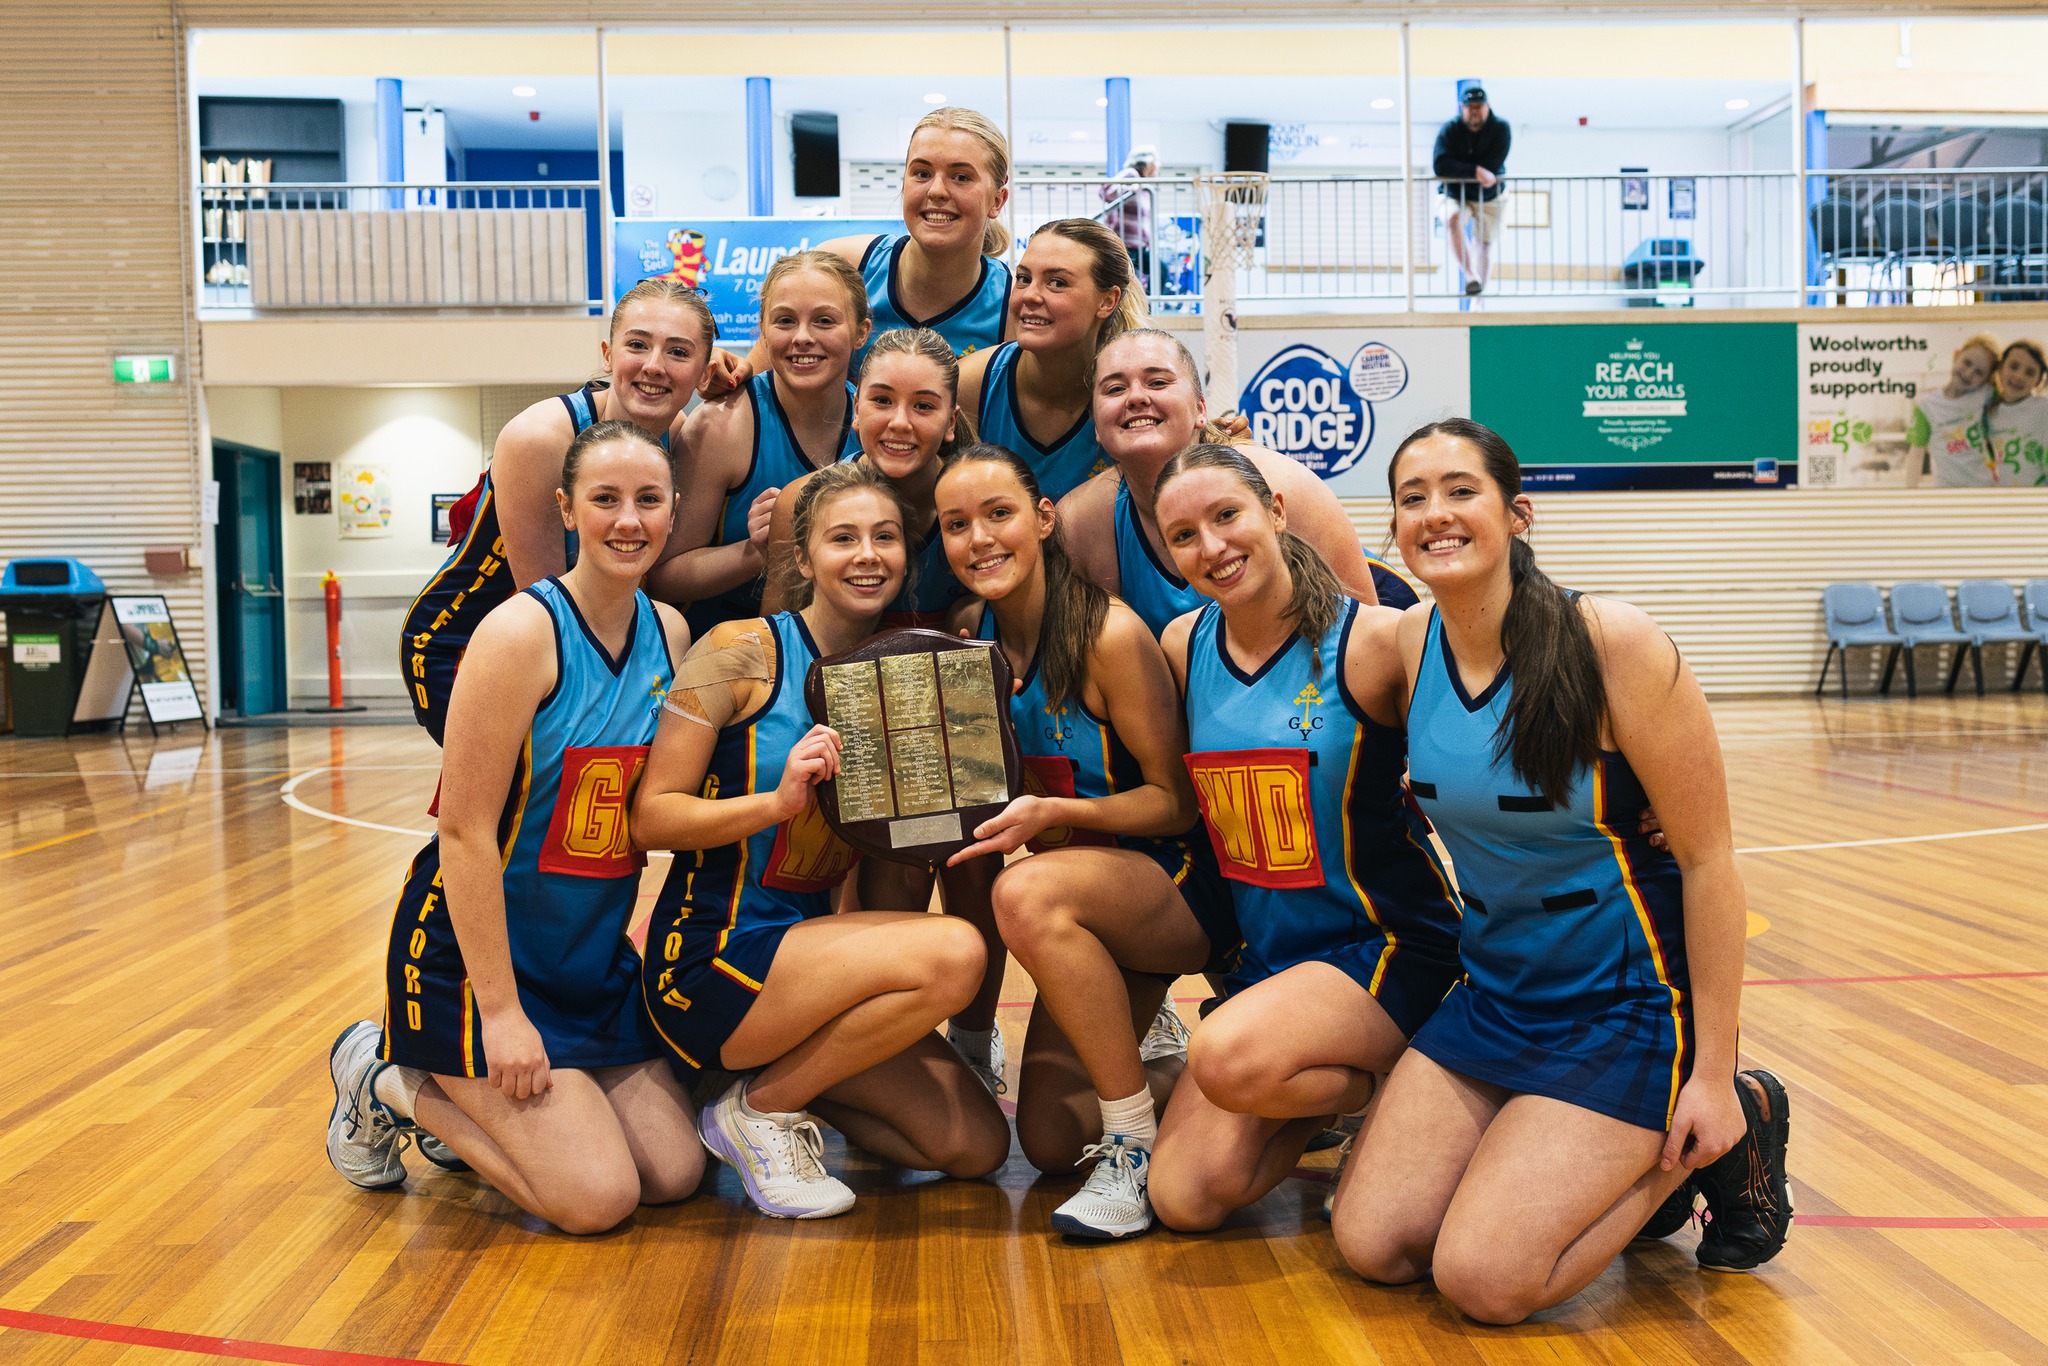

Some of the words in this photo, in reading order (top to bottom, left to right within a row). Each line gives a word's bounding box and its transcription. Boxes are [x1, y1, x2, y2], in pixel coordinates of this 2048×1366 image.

[643, 257, 668, 272] Sock
[713, 238, 814, 275] Laund
[734, 279, 744, 292] 7
[1809, 335, 1928, 351] Woolworths
[1595, 362, 1674, 383] REACH
[1809, 356, 1883, 377] proudly
[1260, 377, 1350, 413] COOL
[1585, 384, 1628, 399] YOUR
[1634, 384, 1686, 399] GOALS
[1809, 379, 1917, 398] supporting
[1253, 411, 1356, 451] RIDGE
[562, 758, 647, 859] G
[1192, 765, 1314, 871] WD
